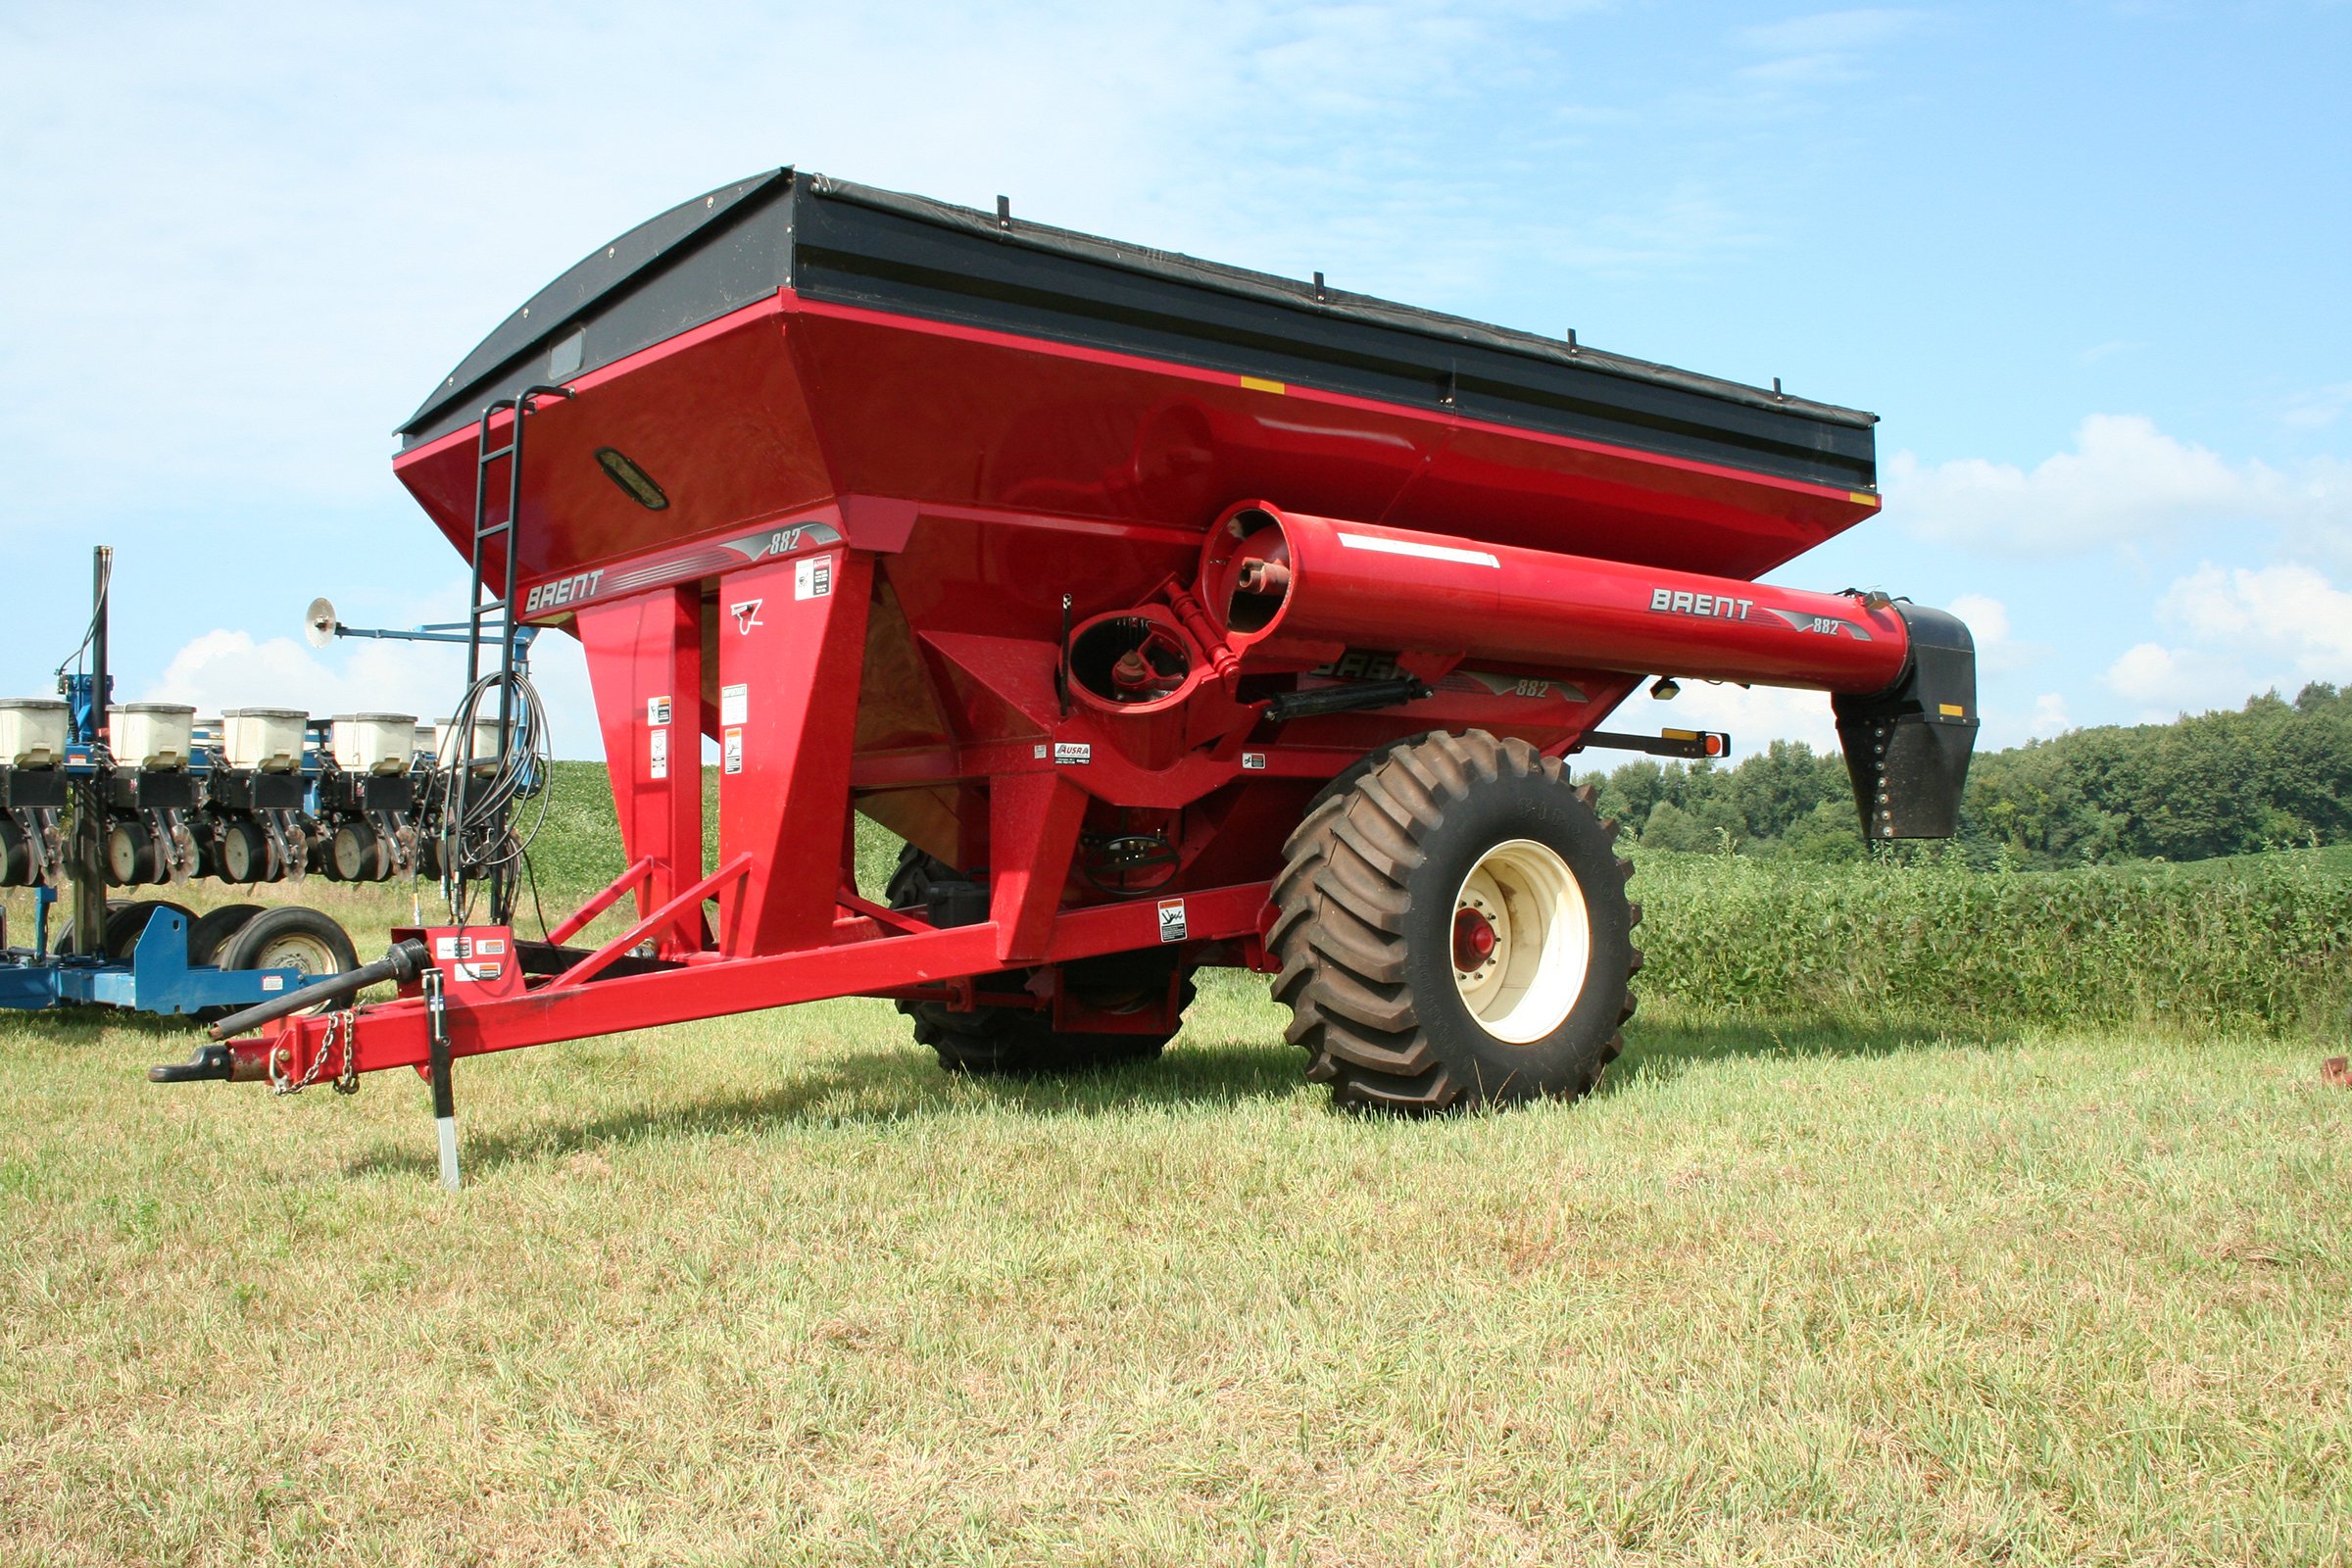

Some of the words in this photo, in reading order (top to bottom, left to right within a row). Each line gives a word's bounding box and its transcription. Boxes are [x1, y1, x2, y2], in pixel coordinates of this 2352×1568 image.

[525, 569, 605, 612] BRENT
[769, 528, 802, 555] 882
[1650, 588, 1754, 620] BRENT
[1813, 617, 1838, 635] 882
[1515, 678, 1548, 698] 882
[1056, 744, 1089, 755] AUSRA
